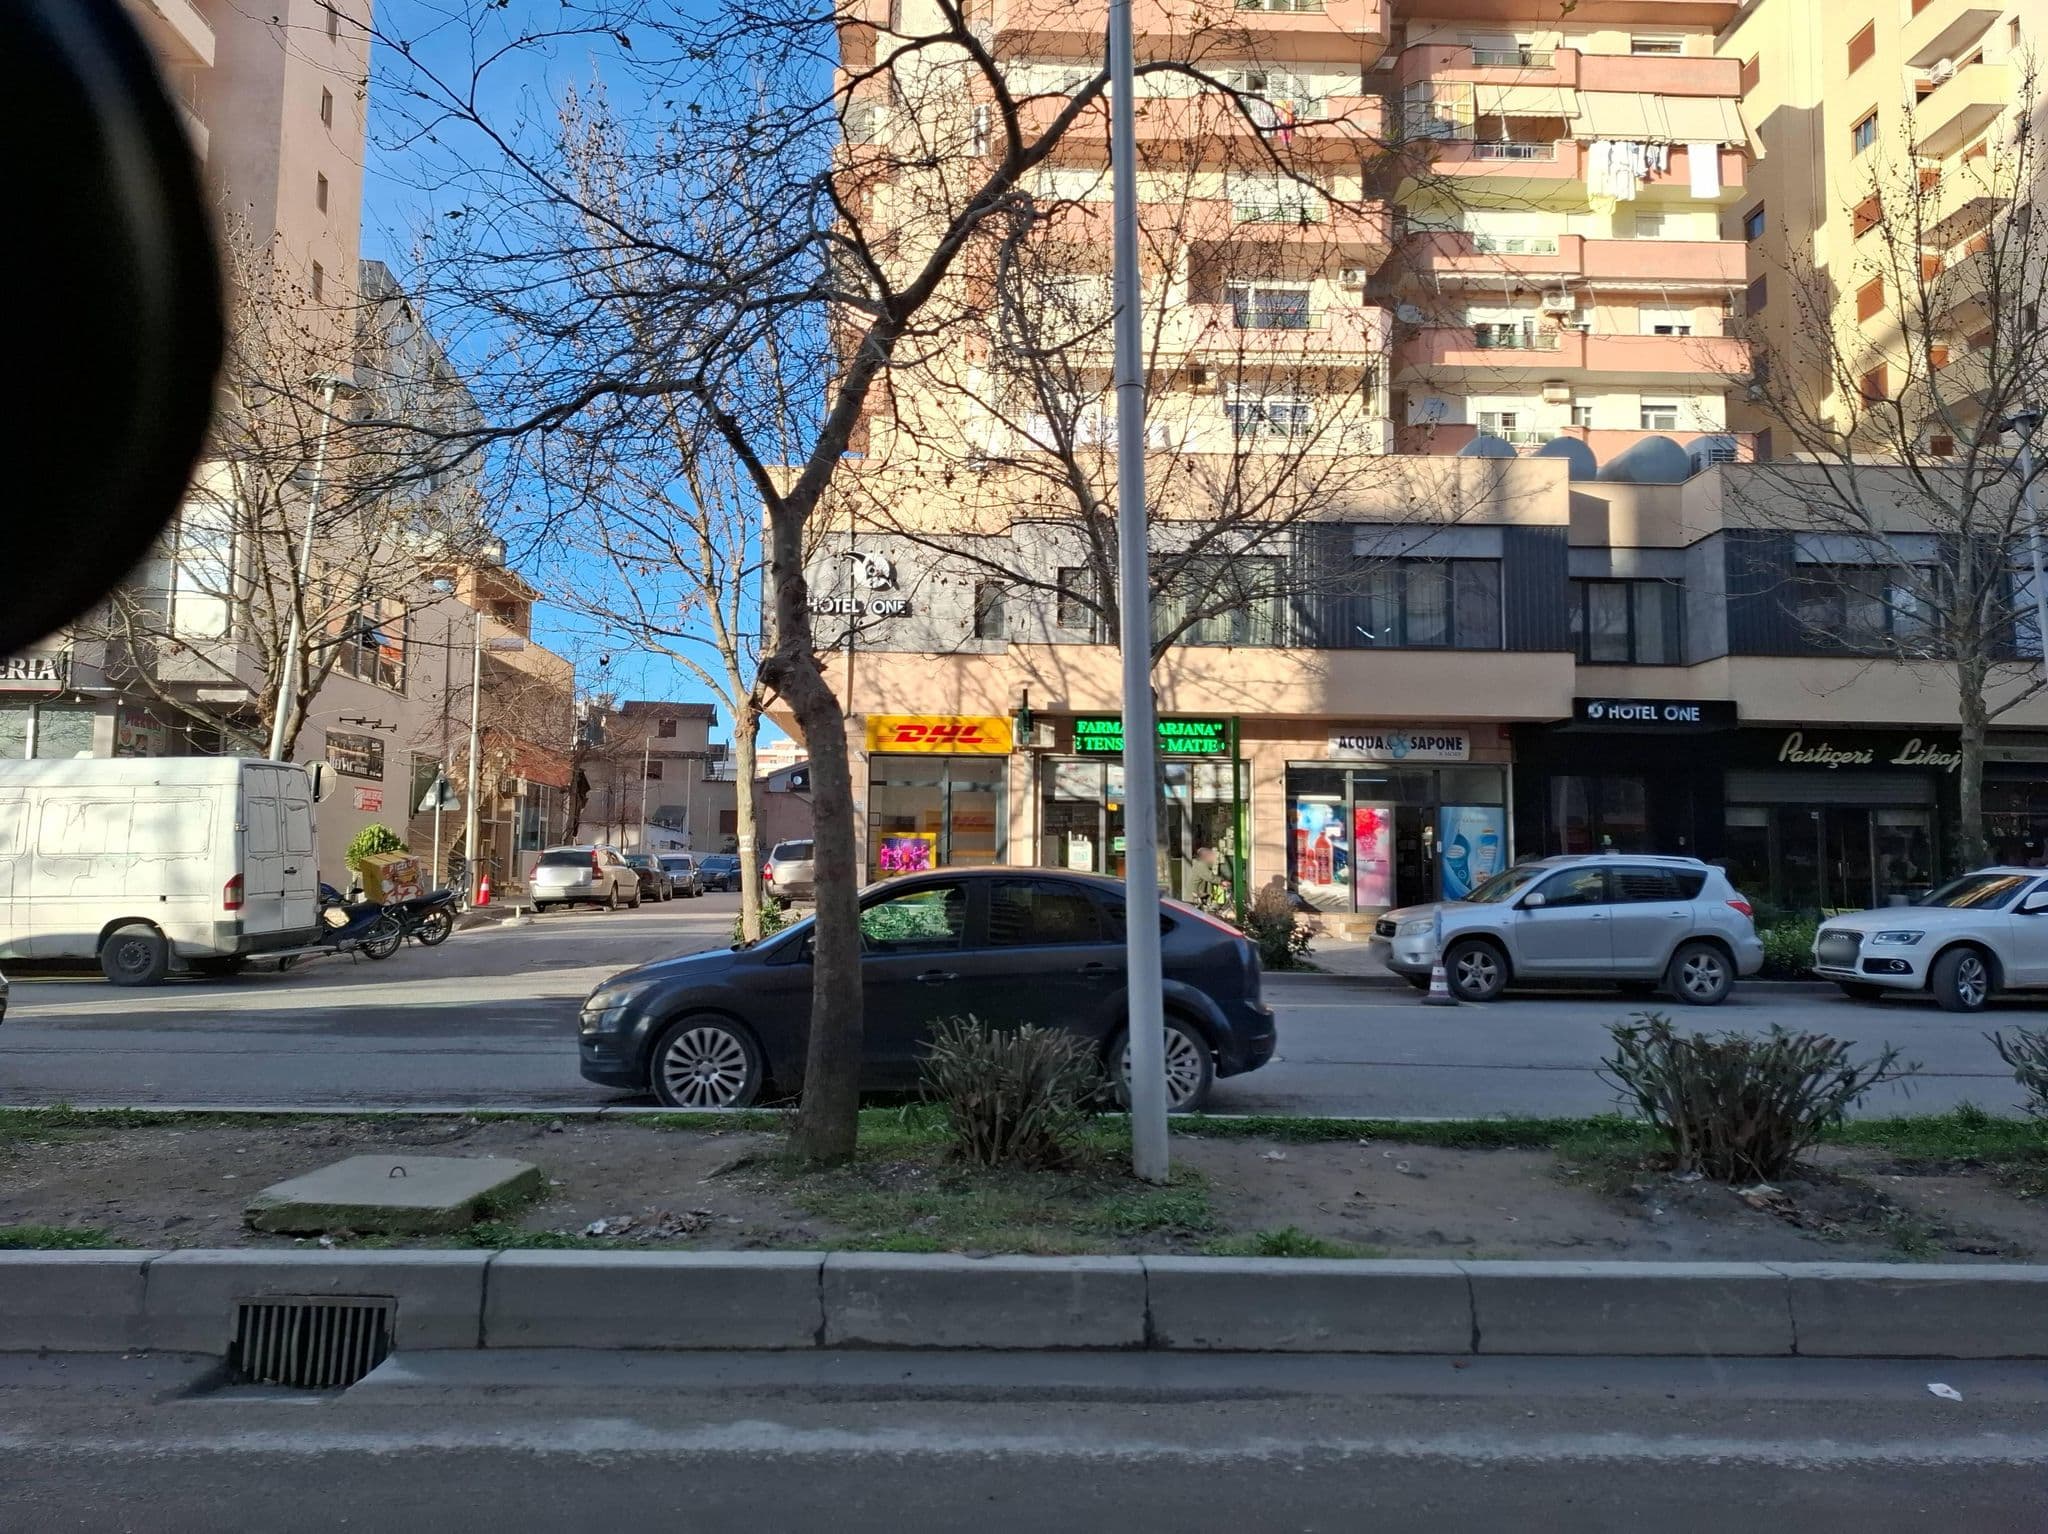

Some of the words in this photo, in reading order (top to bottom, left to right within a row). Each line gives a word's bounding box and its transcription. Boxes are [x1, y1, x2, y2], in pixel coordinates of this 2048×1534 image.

[807, 598, 860, 613] HOTEL
[872, 599, 907, 614] ONE
[1608, 705, 1658, 720] HOTEL
[1664, 706, 1700, 721] ONE
[895, 725, 984, 744] DHL
[1084, 737, 1125, 751] TENS
[1167, 738, 1218, 752] MATJE
[1339, 736, 1384, 750] ACQUA
[1410, 737, 1463, 750] SAPONE
[1778, 732, 1873, 769] Pastiçeri
[1889, 738, 1962, 773] Likaj
